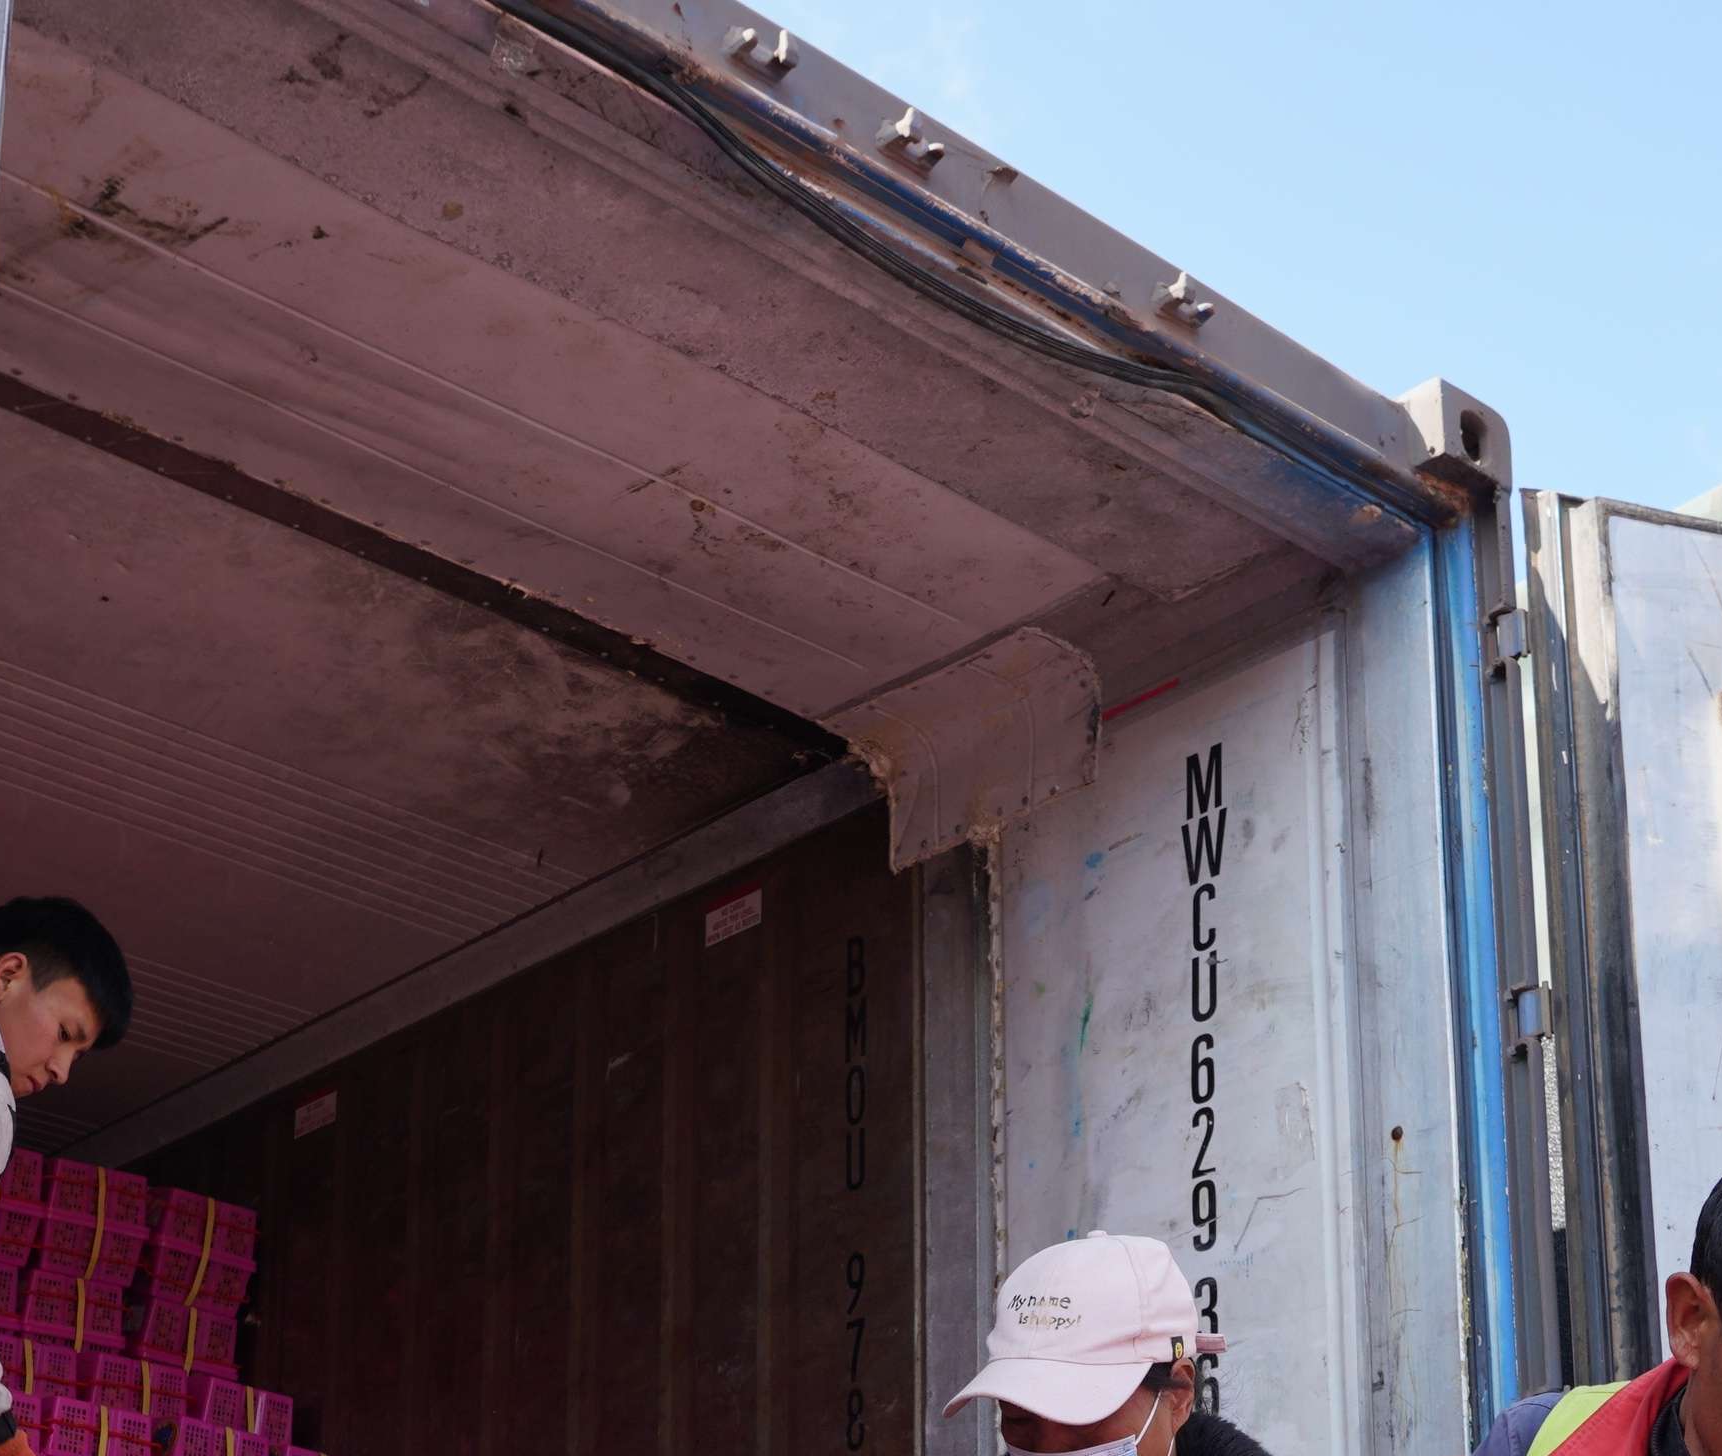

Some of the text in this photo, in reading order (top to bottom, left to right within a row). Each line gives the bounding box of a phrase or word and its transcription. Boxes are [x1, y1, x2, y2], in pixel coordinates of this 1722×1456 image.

[1182, 742, 1227, 1023] MWCU
[844, 934, 867, 1192] BMOU
[1007, 1294, 1071, 1312] My name
[1018, 1312, 1028, 1325] is
